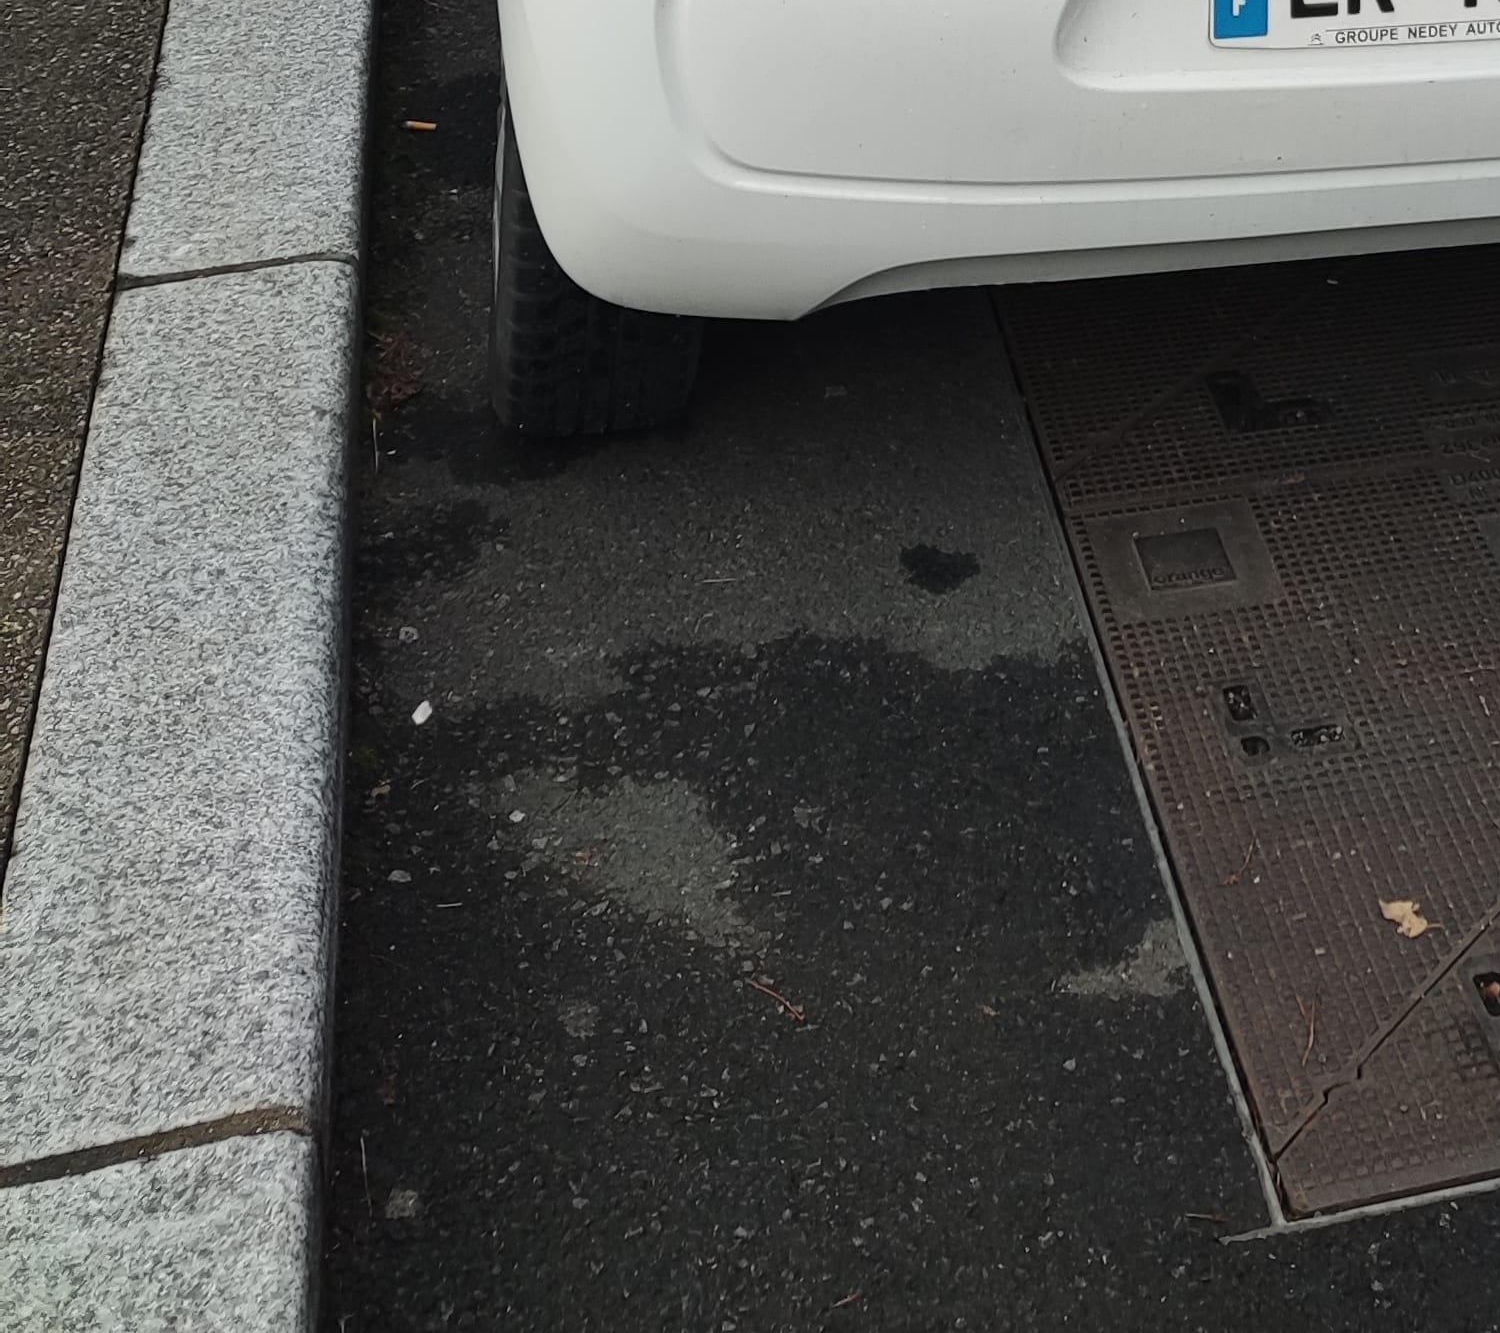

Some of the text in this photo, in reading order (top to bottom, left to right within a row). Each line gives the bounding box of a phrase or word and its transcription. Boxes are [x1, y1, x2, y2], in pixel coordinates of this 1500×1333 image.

[1335, 29, 1399, 44] GROUPE
[1408, 23, 1457, 39] NEDEY
[1153, 566, 1225, 584] orange
